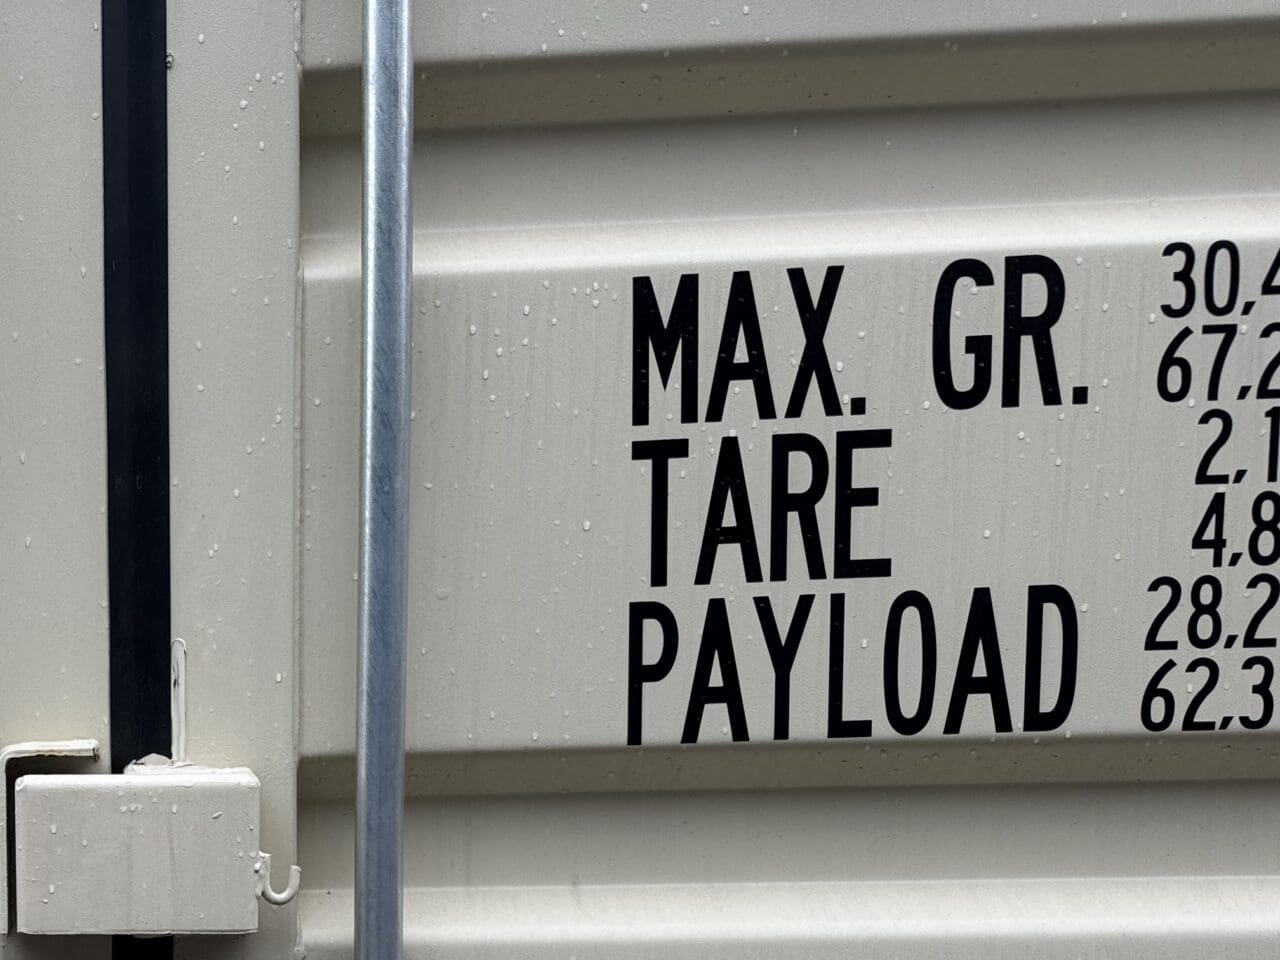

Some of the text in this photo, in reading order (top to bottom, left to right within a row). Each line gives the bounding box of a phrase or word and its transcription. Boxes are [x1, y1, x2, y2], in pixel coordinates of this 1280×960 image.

[631, 265, 867, 427] MAX.
[931, 254, 1089, 411] GR.
[631, 428, 893, 588] TARE
[626, 584, 1079, 746] PAYLOAD
